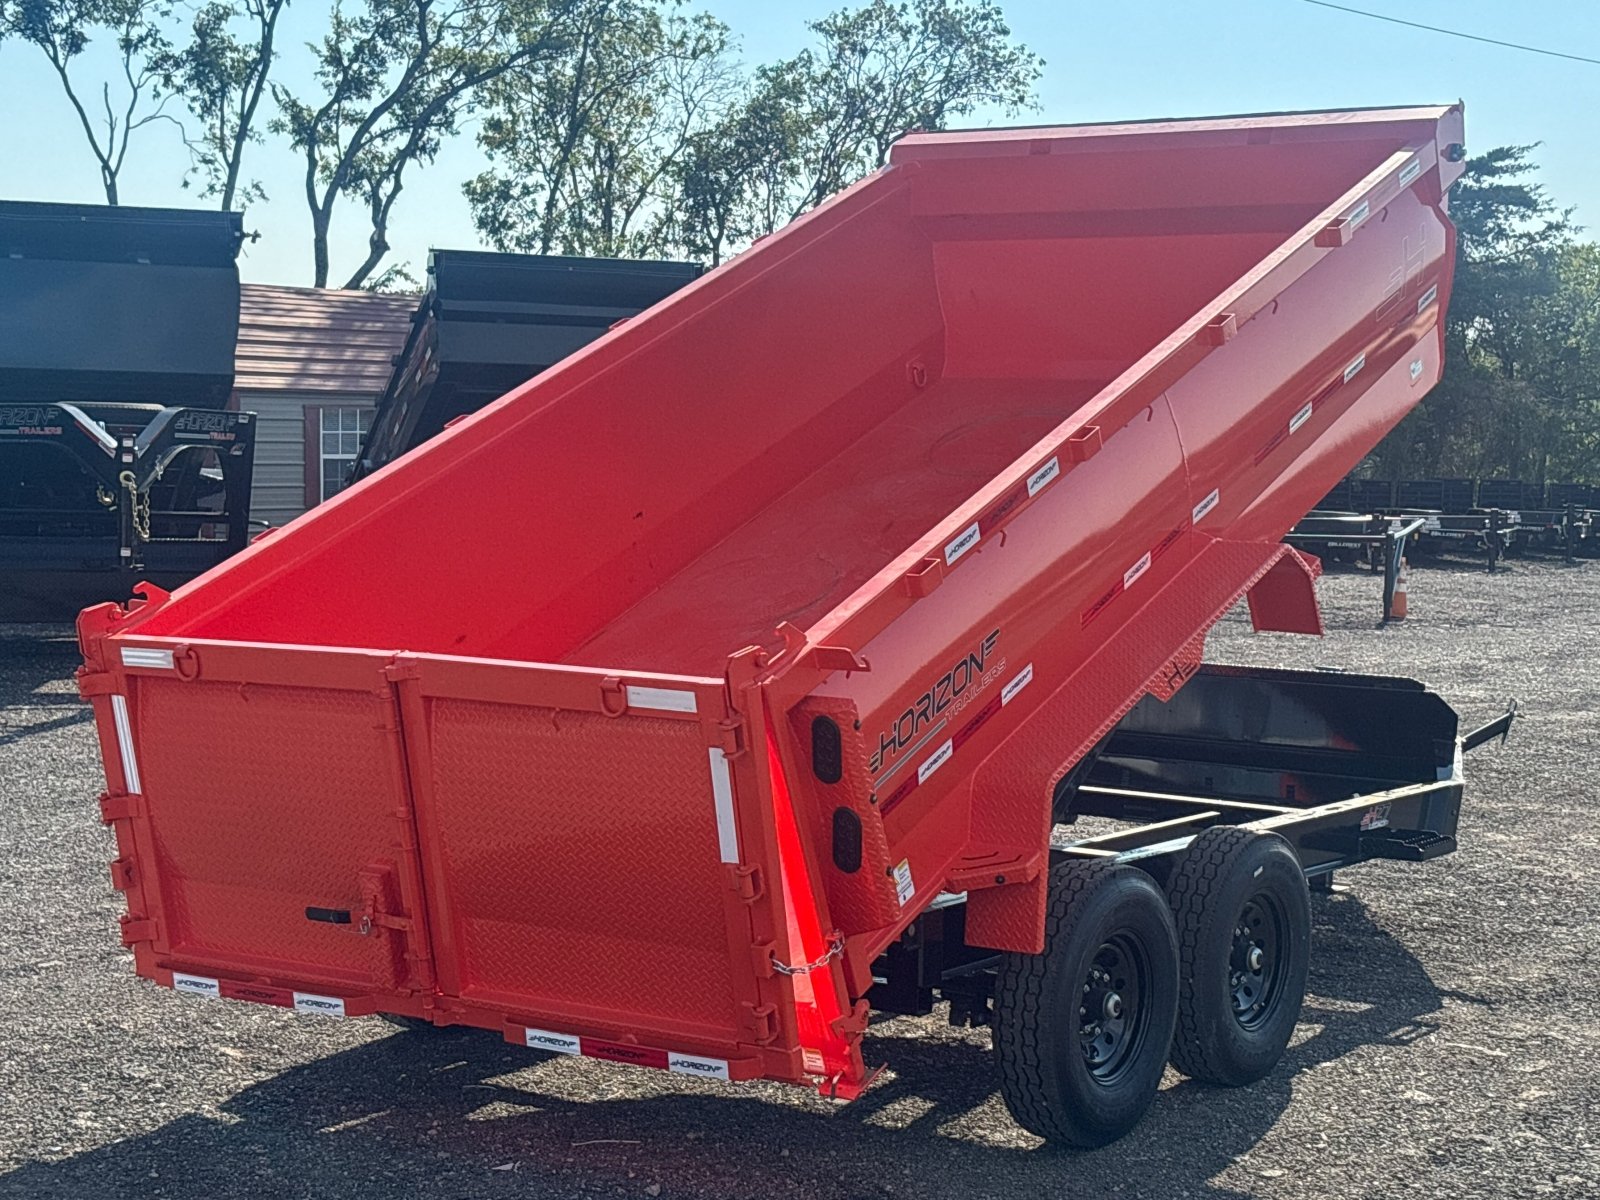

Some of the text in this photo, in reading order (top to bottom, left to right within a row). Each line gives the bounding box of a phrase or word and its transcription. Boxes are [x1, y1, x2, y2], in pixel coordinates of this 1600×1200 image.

[945, 657, 1006, 721] TRAILERS
[870, 629, 1000, 774] HORIZON
[176, 979, 217, 991] HORIZON
[297, 998, 342, 1010] HORIZON
[528, 1034, 577, 1048] HORIZON
[670, 1058, 723, 1073] HORIZON
